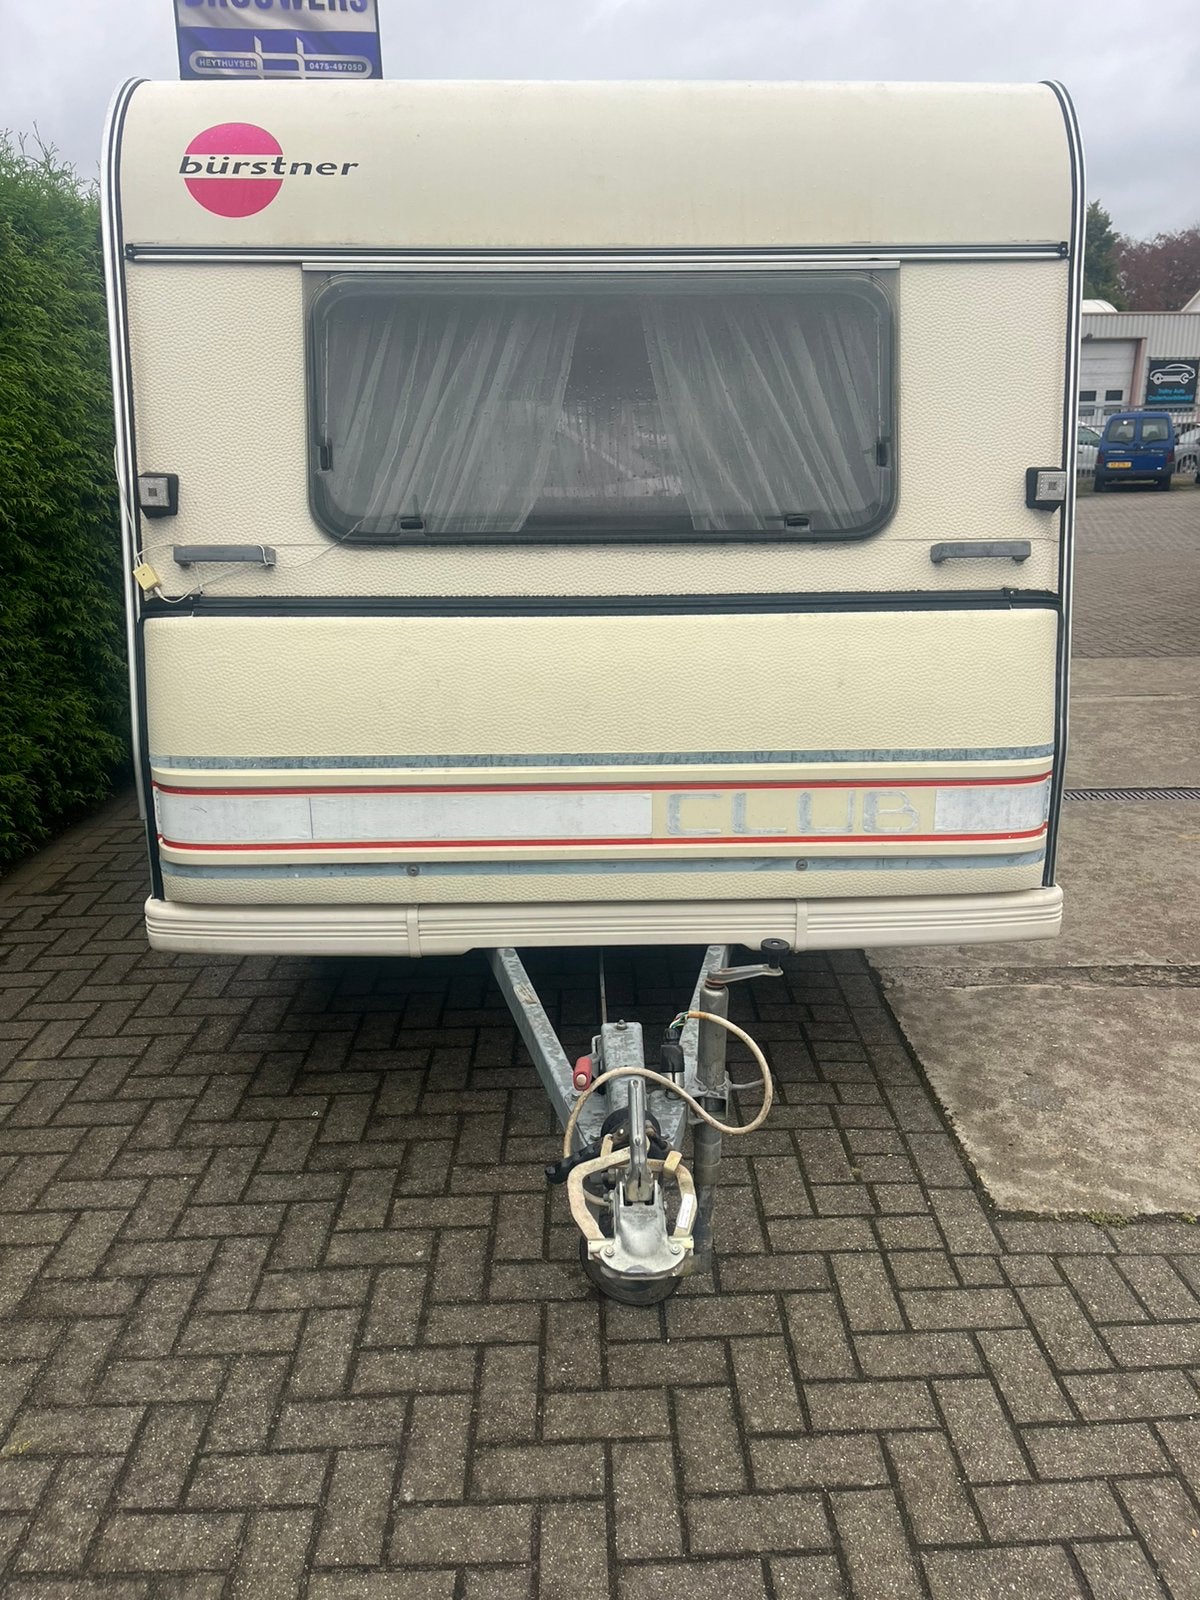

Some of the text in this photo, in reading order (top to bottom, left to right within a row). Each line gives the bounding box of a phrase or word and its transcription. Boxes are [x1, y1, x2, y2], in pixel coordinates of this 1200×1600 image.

[199, 57, 257, 68] HEYTHUYSEN
[179, 156, 359, 176] bürstner
[667, 790, 920, 835] CLUB
